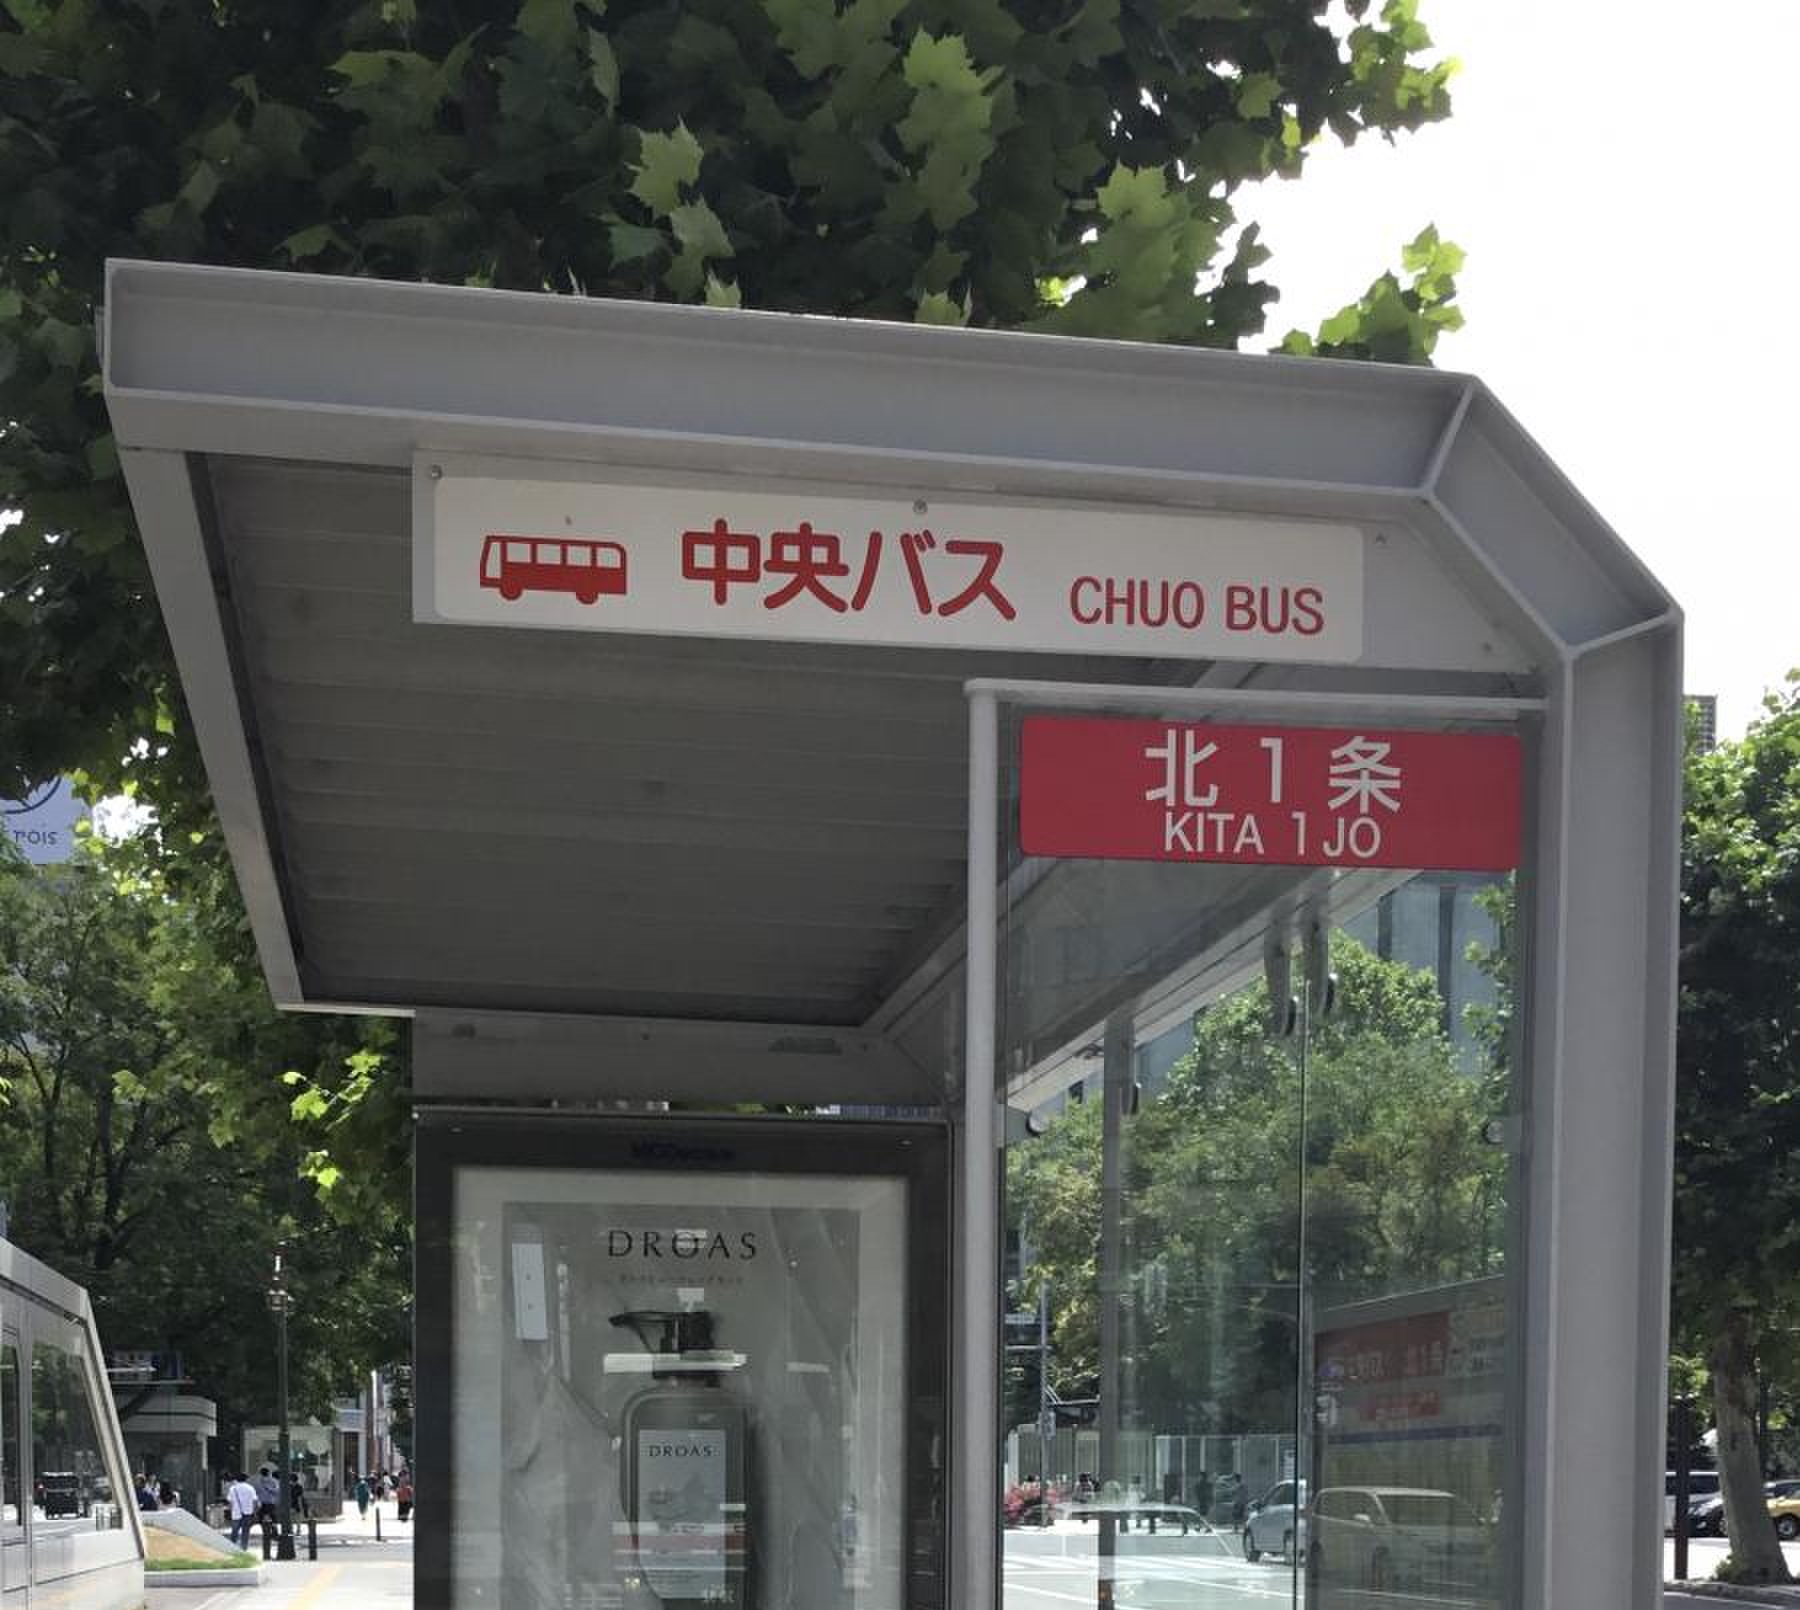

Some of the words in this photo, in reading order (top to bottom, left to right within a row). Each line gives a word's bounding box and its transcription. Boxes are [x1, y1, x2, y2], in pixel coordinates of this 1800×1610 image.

[680, 519, 1018, 621] 中央バス
[1069, 574, 1206, 631] CHUO
[1226, 586, 1325, 636] BUS
[1164, 810, 1265, 856] KITA
[1290, 812, 1306, 856] 1
[1322, 816, 1383, 860] JO
[608, 1230, 757, 1260] DROAS
[648, 1444, 713, 1457] DROAS
